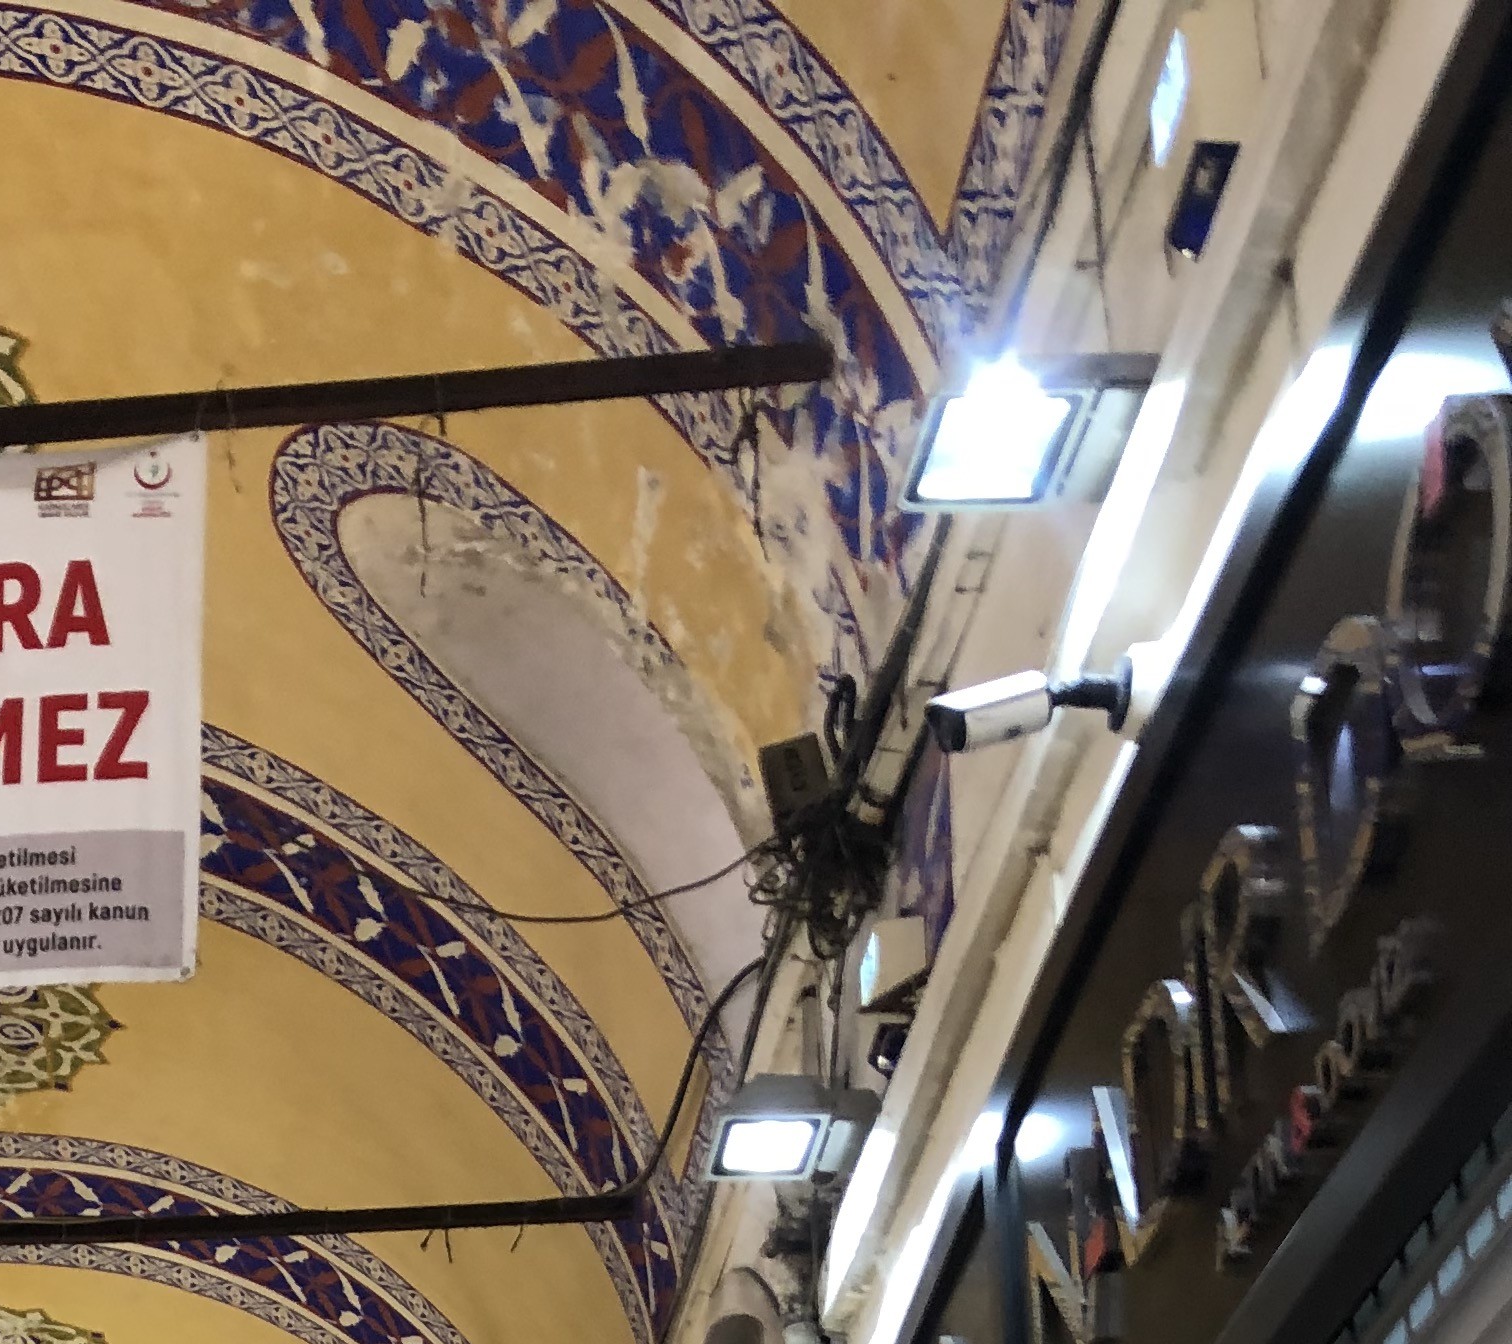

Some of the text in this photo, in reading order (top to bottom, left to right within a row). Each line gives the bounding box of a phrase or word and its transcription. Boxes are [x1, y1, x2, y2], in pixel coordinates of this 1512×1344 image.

[29, 903, 82, 926] sayılı
[88, 901, 149, 922] kanun
[2, 932, 102, 958] uygulanır.
